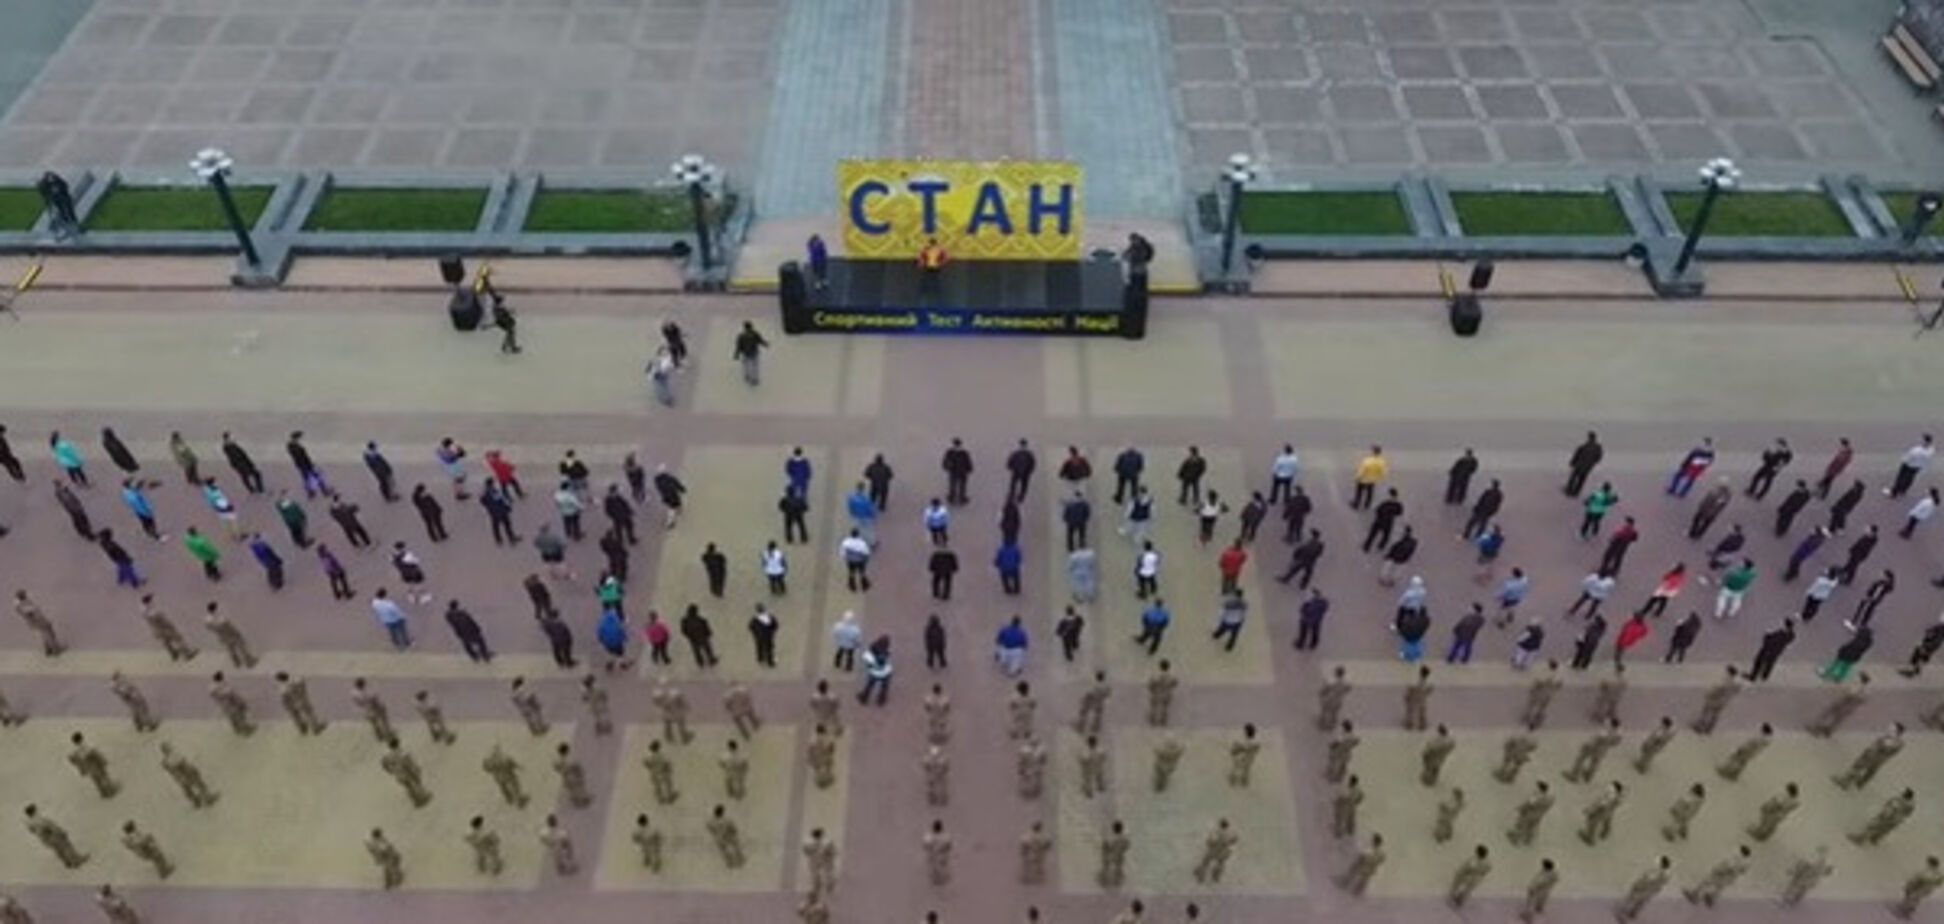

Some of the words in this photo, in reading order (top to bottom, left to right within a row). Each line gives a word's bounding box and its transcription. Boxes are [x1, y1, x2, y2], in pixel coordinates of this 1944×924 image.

[849, 180, 1075, 235] СТАН
[813, 311, 918, 328] Спортивний
[928, 312, 963, 326] Тест
[972, 313, 1066, 328] Активності
